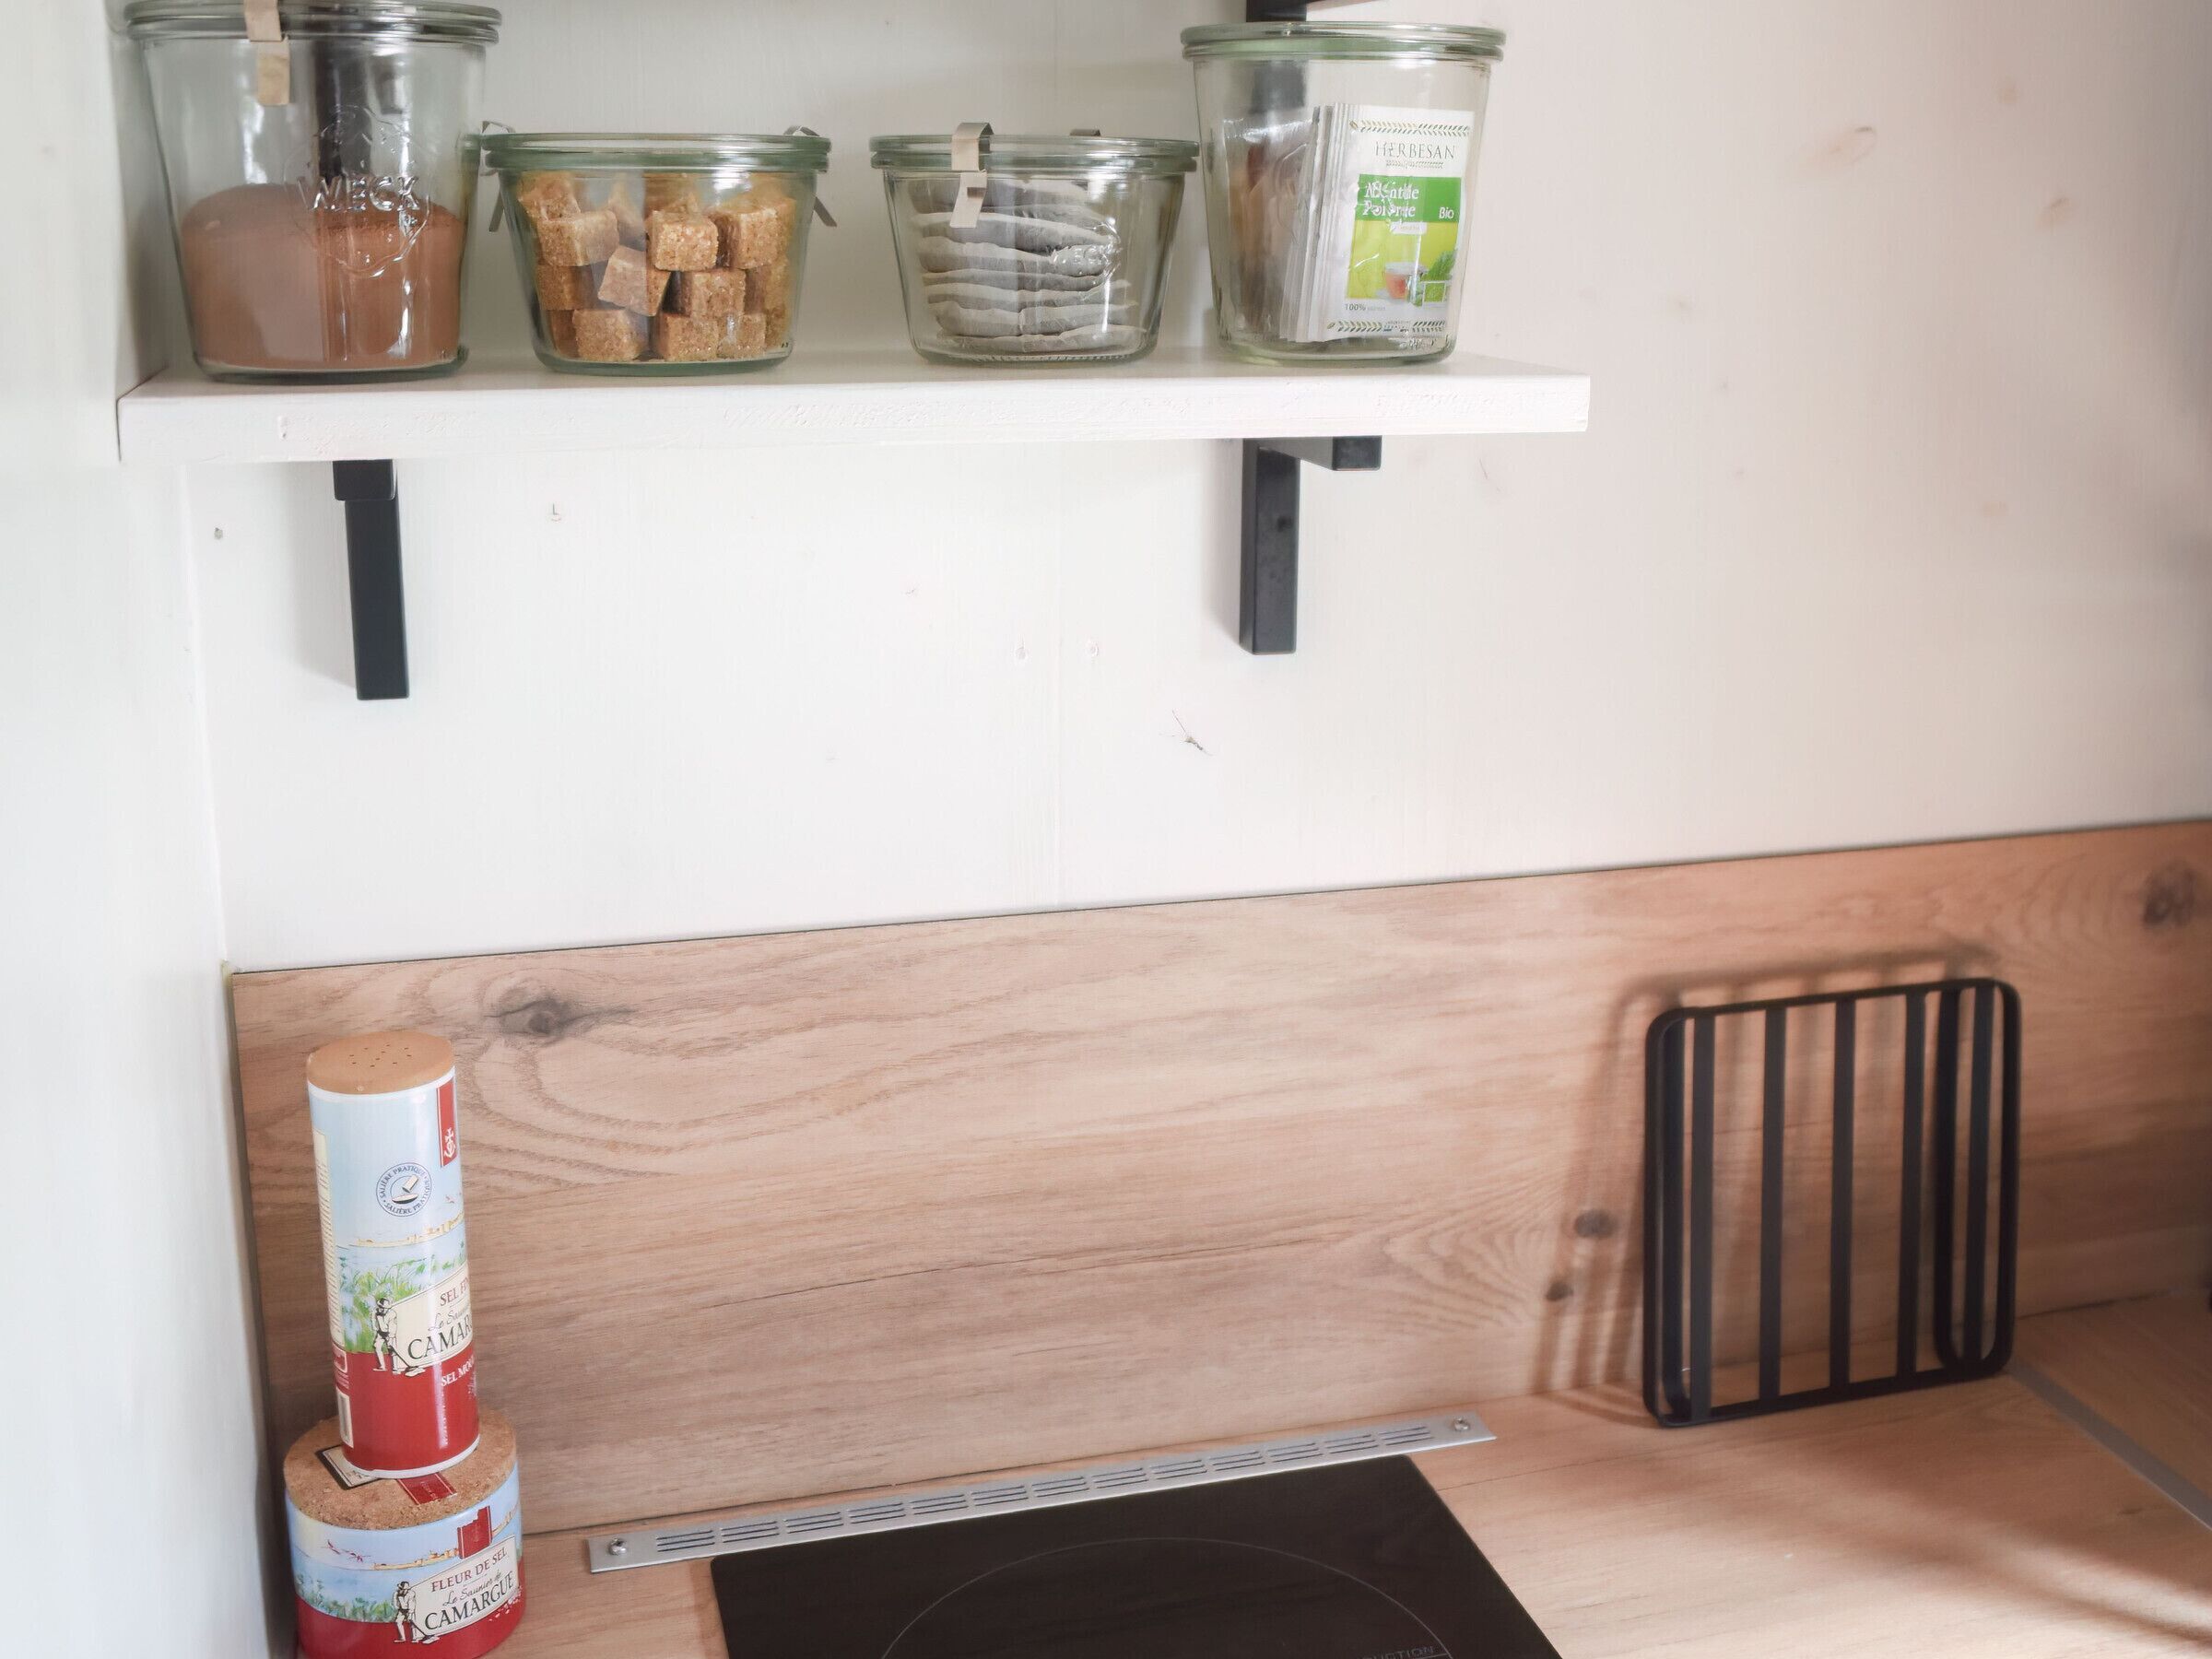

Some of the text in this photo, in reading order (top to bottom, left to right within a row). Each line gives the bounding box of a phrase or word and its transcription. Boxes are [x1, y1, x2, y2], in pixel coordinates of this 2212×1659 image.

[1375, 141, 1455, 159] HERBESAN
[1439, 206, 1454, 219] Bio
[1344, 302, 1367, 312] 100%
[440, 1291, 459, 1306] SEL
[441, 1371, 458, 1387] SEL
[431, 1547, 507, 1592] FLEUR DE SEL
[425, 1571, 514, 1630] CAMARGUE
[442, 1590, 458, 1606] Le
